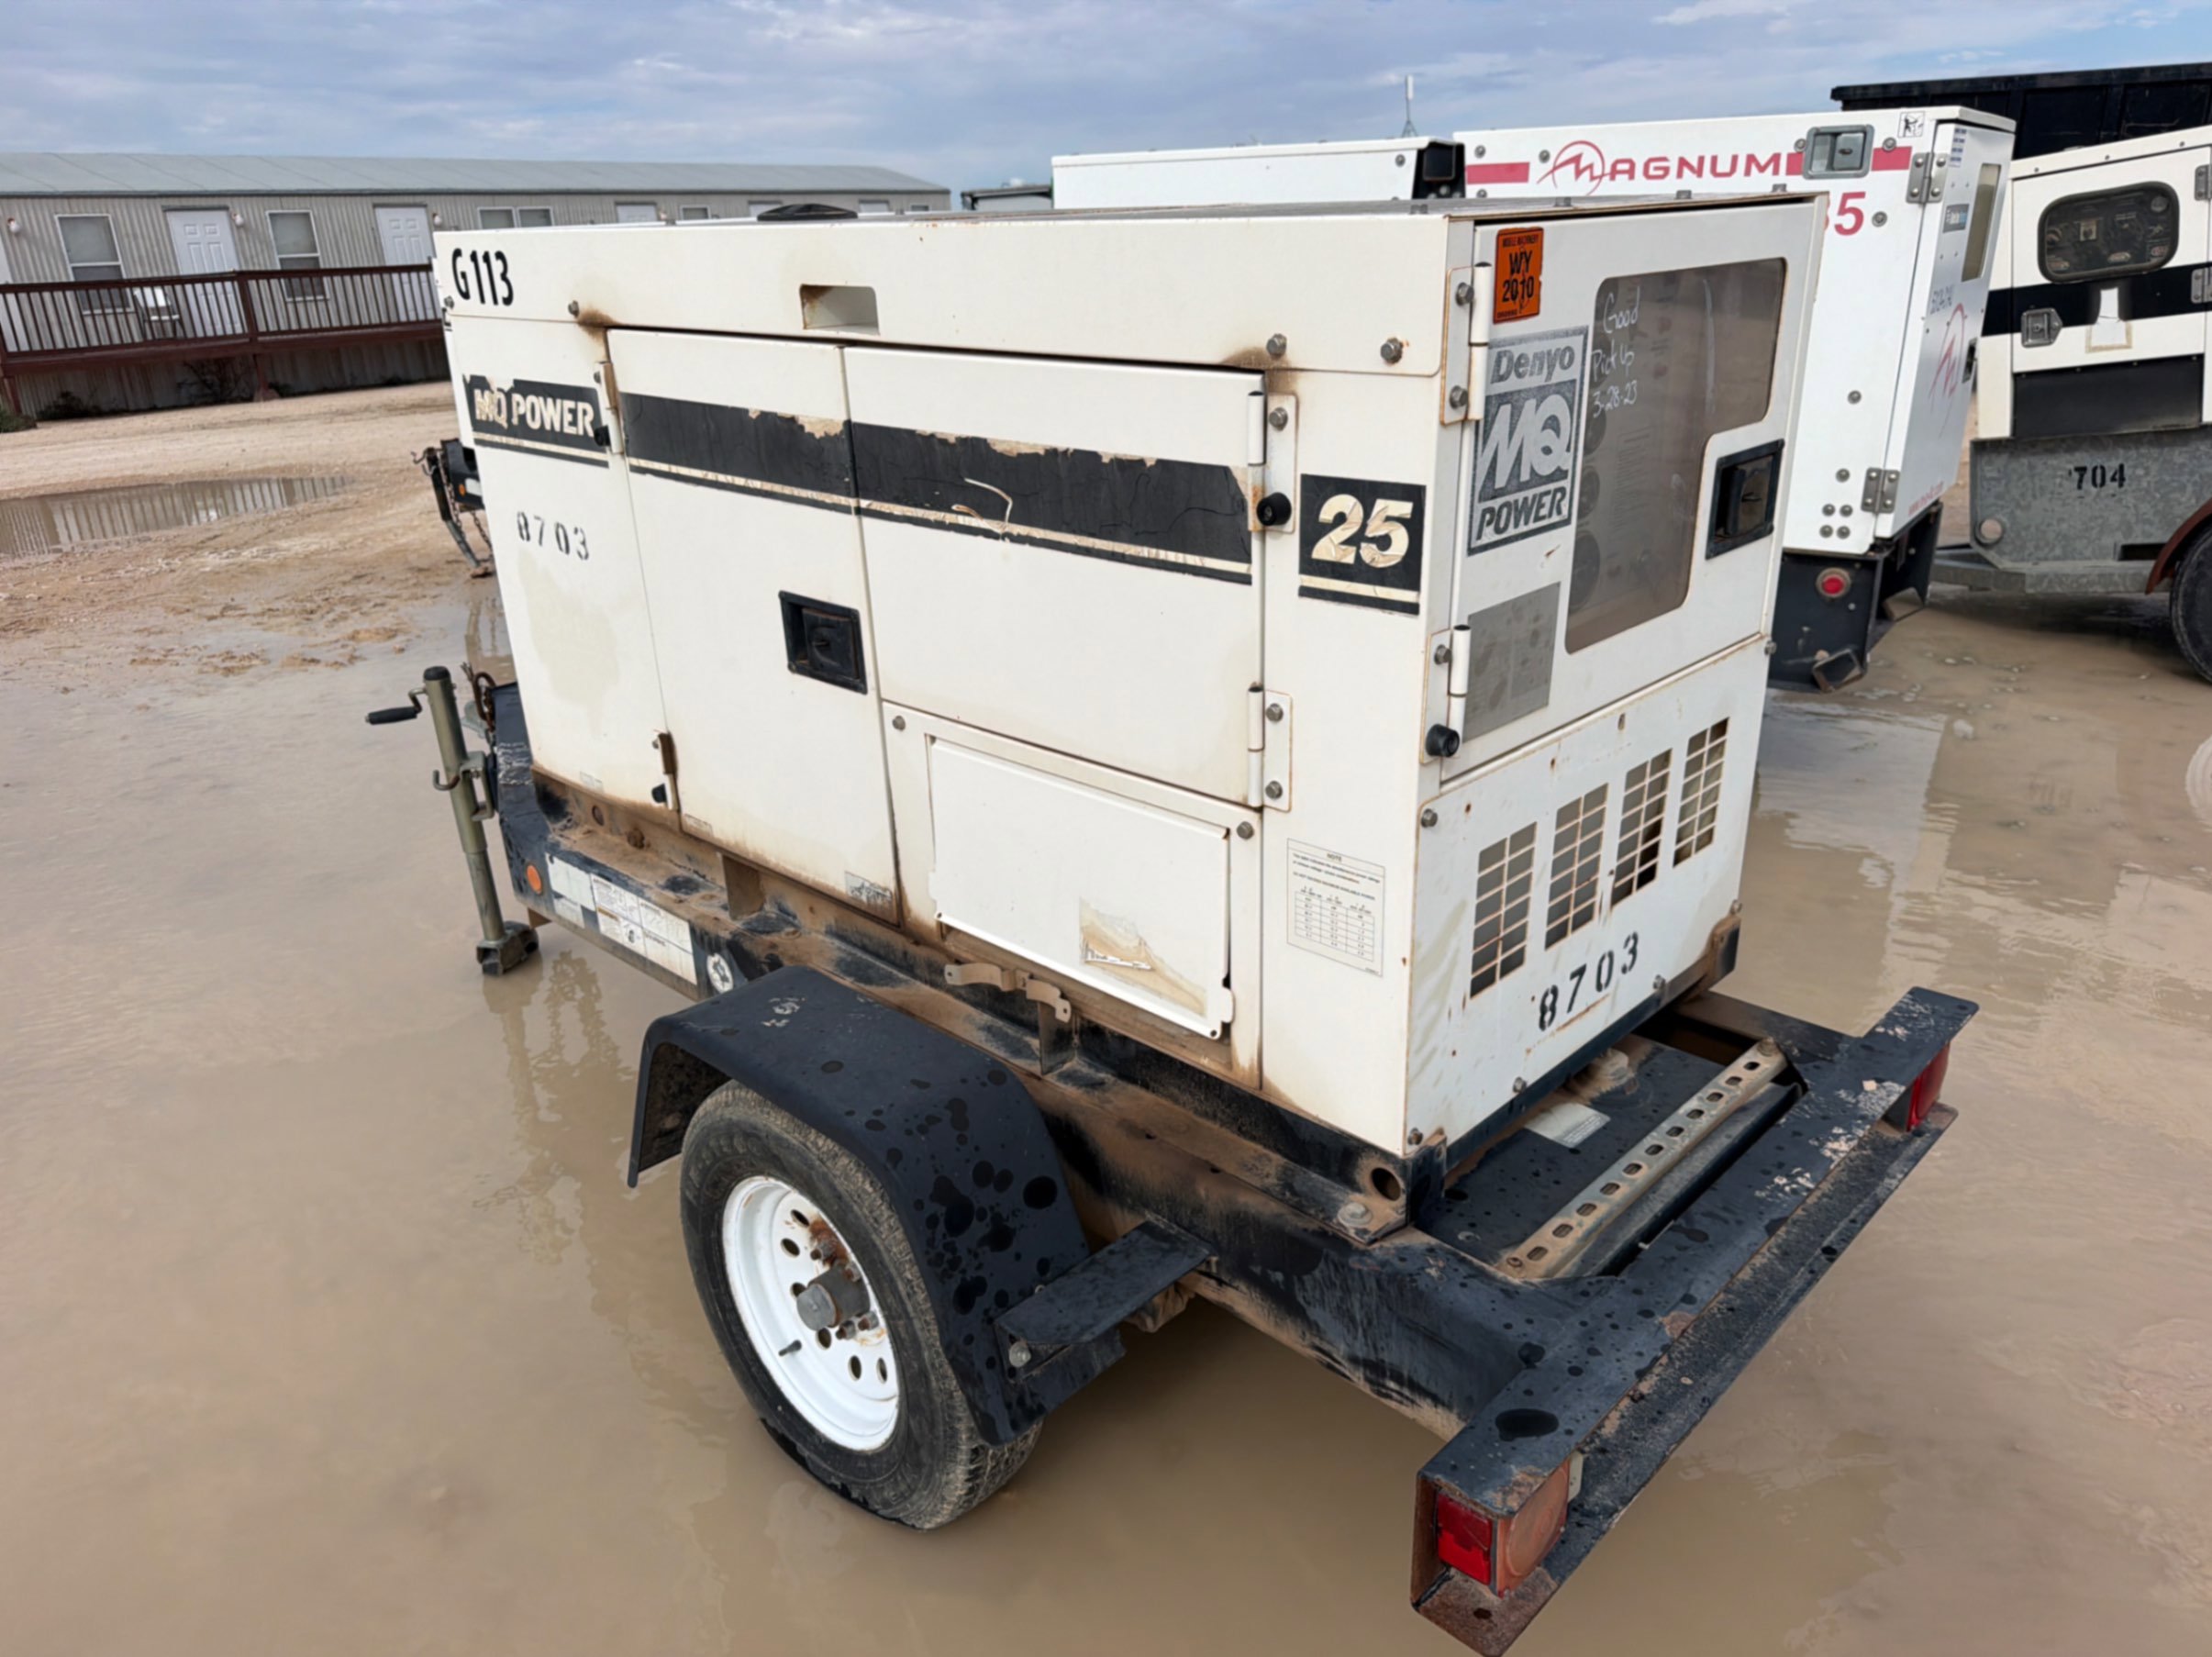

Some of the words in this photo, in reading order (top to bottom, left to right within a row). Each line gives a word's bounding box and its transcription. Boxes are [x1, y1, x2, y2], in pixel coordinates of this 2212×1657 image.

[1537, 148, 1783, 186] MAGNUM
[1823, 191, 1866, 236] 5
[451, 247, 514, 306] G113
[1508, 250, 1533, 274] WY
[1501, 275, 1535, 303] 2010
[1603, 285, 1641, 334] Good
[1490, 345, 1575, 384] Denyo
[473, 387, 508, 429] MQ
[511, 393, 595, 438] POWER
[1478, 393, 1572, 493] MQ
[2073, 462, 2127, 491] 704
[517, 511, 590, 561] 8703
[1310, 493, 1414, 569] 25
[1475, 485, 1567, 541] POWER
[1538, 930, 1639, 1032] 8703
